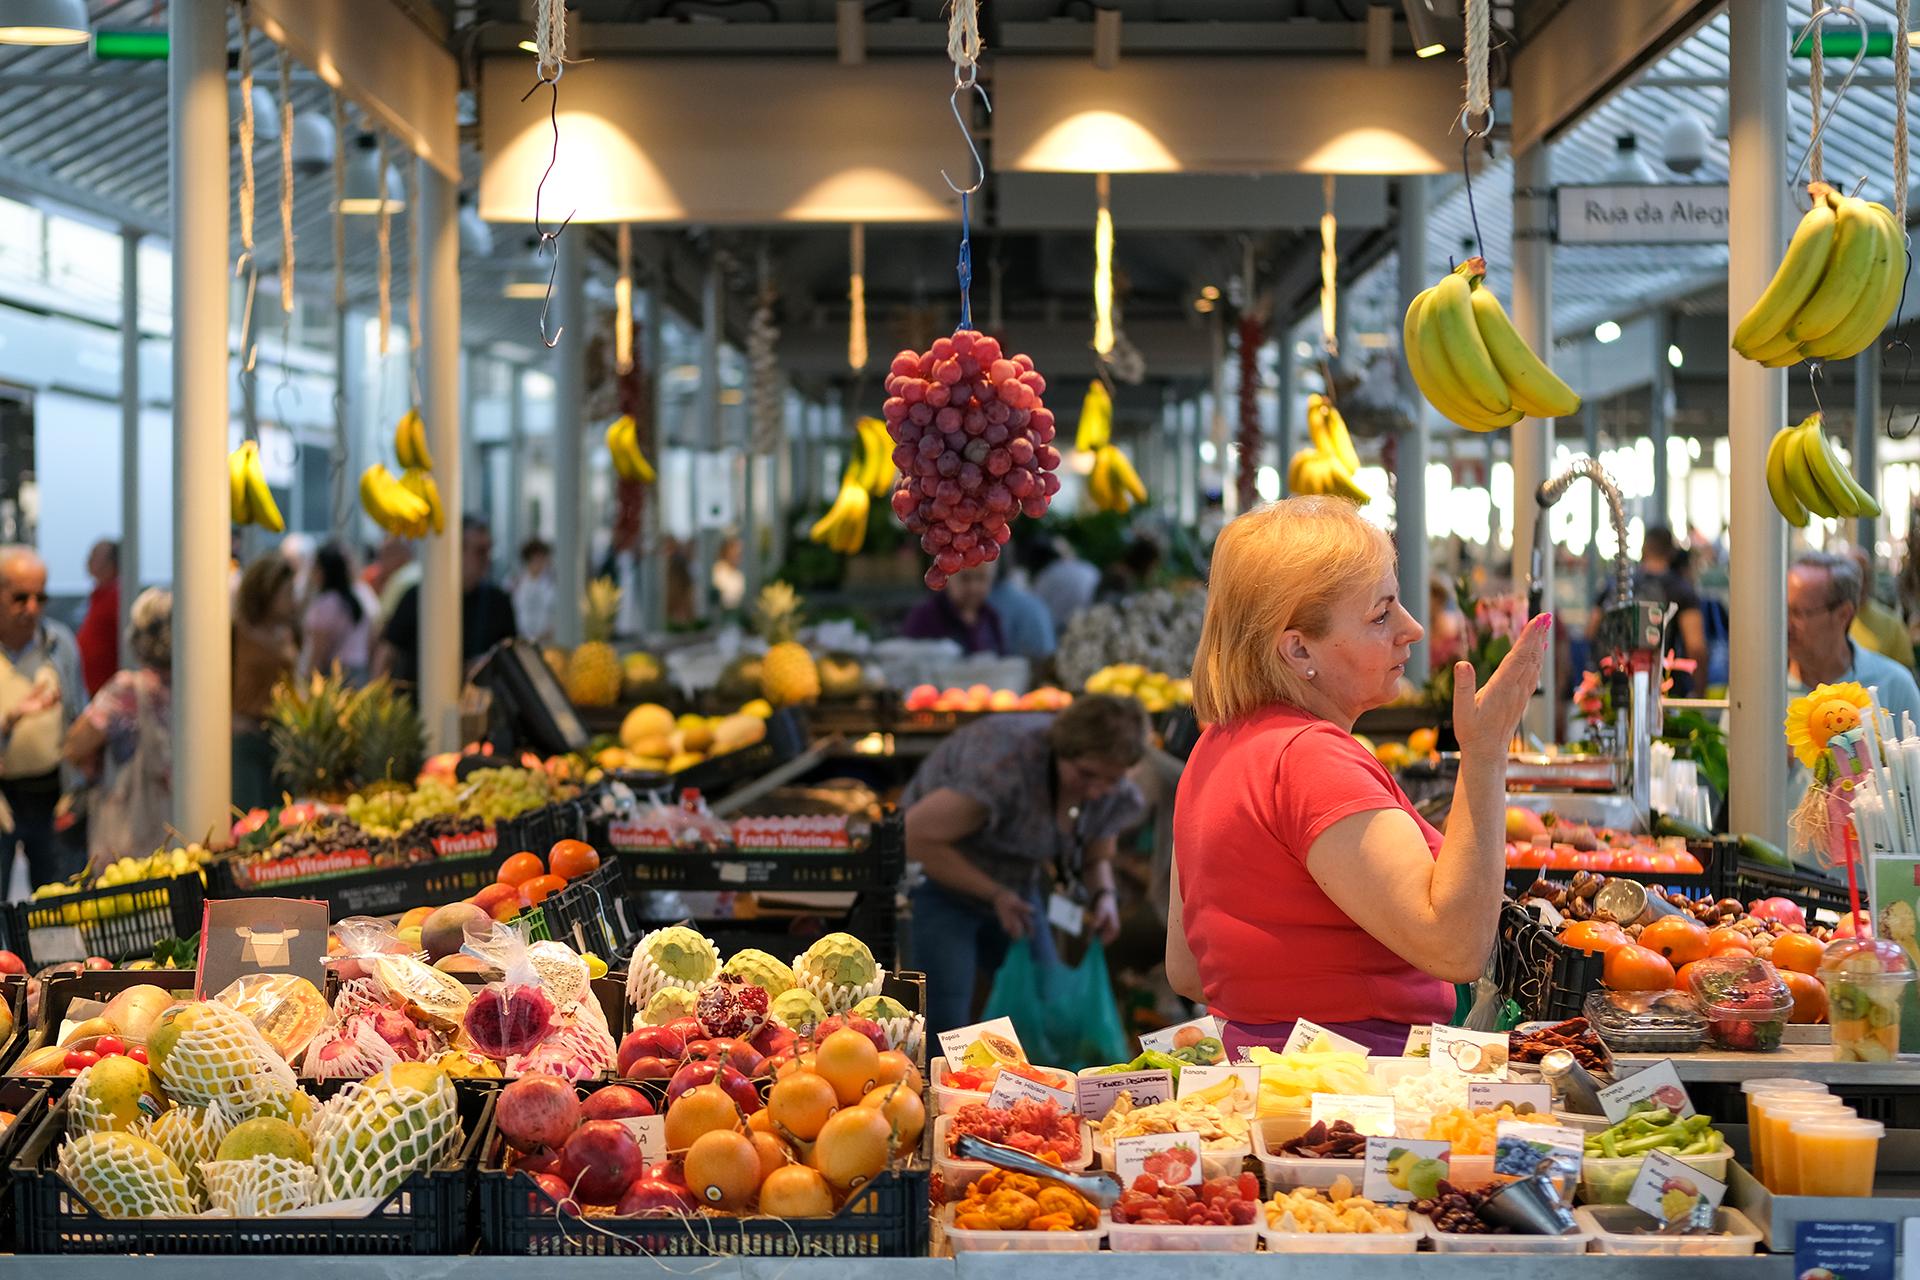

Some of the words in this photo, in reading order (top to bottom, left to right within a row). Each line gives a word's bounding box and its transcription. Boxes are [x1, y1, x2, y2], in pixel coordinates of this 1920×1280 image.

[1585, 201, 1629, 223] Rua
[1635, 201, 1663, 222] da
[440, 838, 482, 855] Frutas
[739, 832, 778, 847] Frutas
[780, 831, 832, 847] Vitorino
[255, 864, 297, 881] Frutas
[298, 856, 353, 873] Vitorino
[1143, 1036, 1158, 1046] Kiwi
